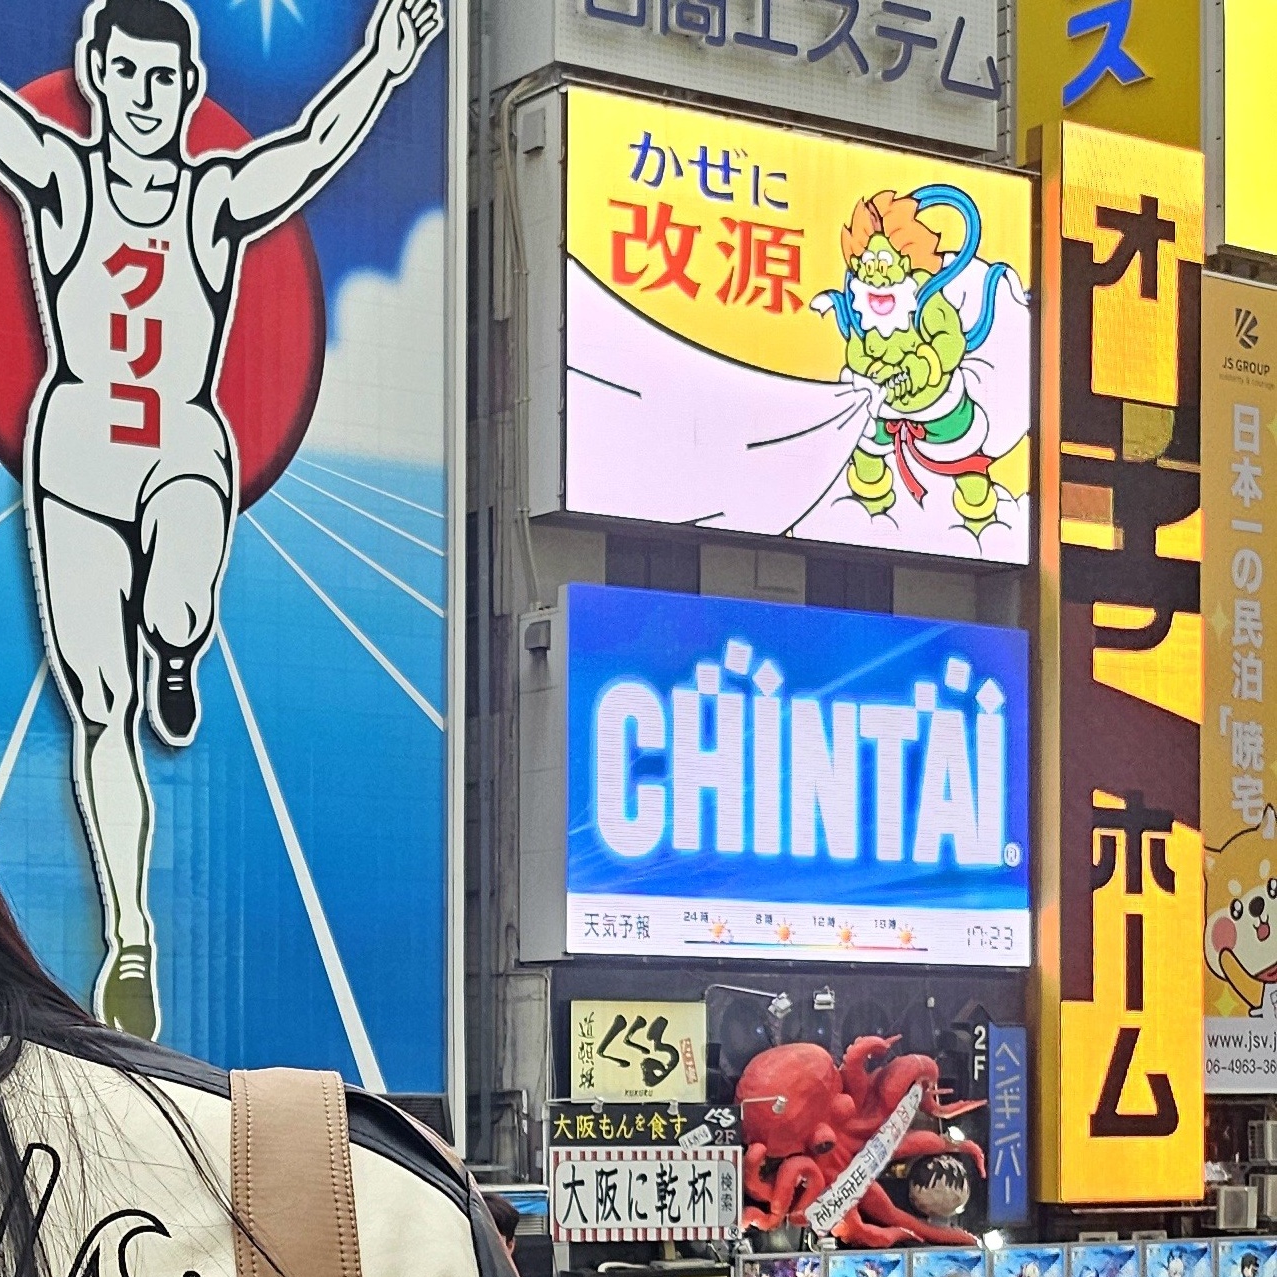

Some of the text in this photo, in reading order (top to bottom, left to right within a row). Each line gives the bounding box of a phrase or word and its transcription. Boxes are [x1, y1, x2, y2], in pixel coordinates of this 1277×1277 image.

[629, 131, 789, 209] かぜに
[608, 198, 805, 314] 改源
[102, 238, 170, 449] グリコ
[1222, 357, 1271, 377] JS GROUP
[596, 640, 1005, 866] CHINTAI
[584, 912, 651, 940] 天気予報
[596, 1014, 680, 1088] くくる
[553, 1112, 688, 1141] 大阪もんを食す
[714, 1129, 737, 1145] 2F
[561, 1163, 714, 1225] 大阪に乾杯
